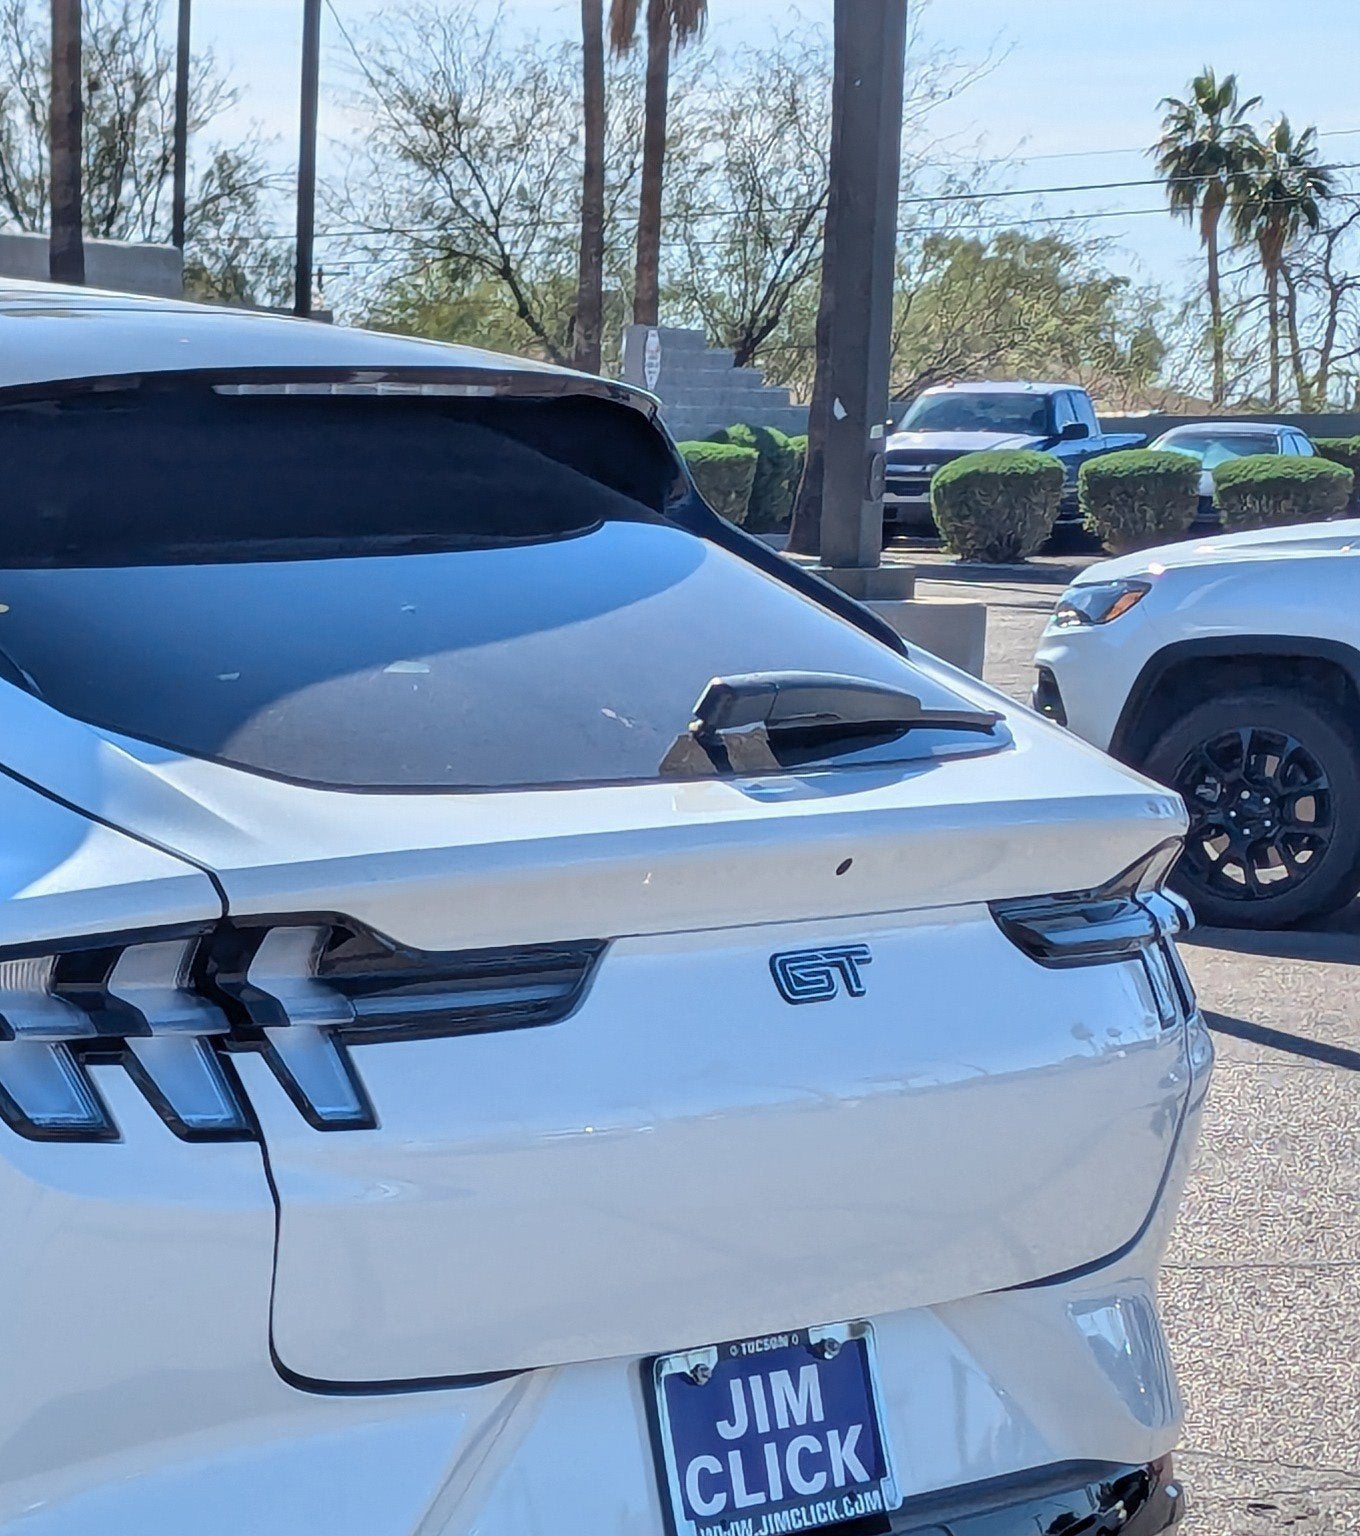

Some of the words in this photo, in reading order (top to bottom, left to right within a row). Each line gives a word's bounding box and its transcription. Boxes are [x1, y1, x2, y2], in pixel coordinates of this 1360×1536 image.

[769, 943, 872, 1005] GT
[740, 1335, 789, 1356] TUCSON
[716, 1363, 825, 1440] JIM
[685, 1424, 871, 1517] CLICK
